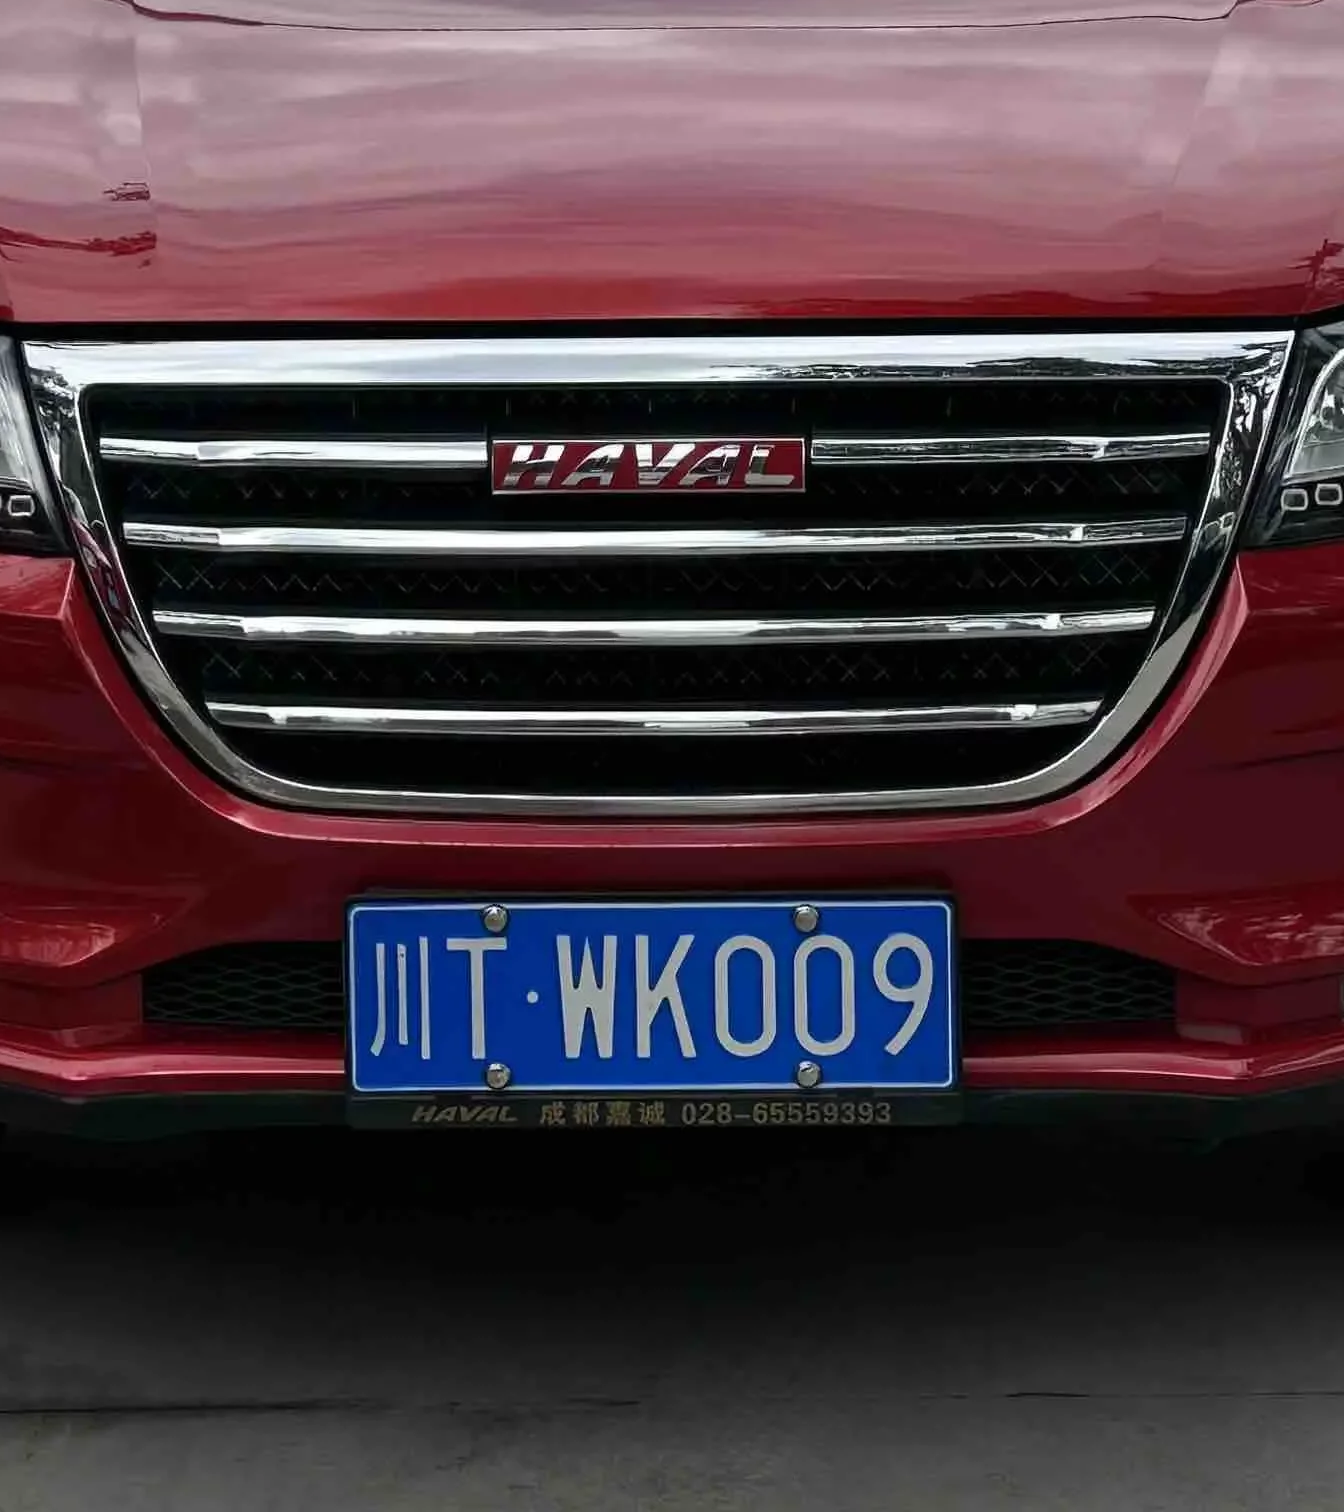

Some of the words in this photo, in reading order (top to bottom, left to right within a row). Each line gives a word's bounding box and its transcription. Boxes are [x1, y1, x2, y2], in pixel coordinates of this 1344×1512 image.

[502, 443, 795, 488] HAVAL
[411, 1104, 518, 1123] HAVAL
[681, 1101, 892, 1125] 028-65559393
